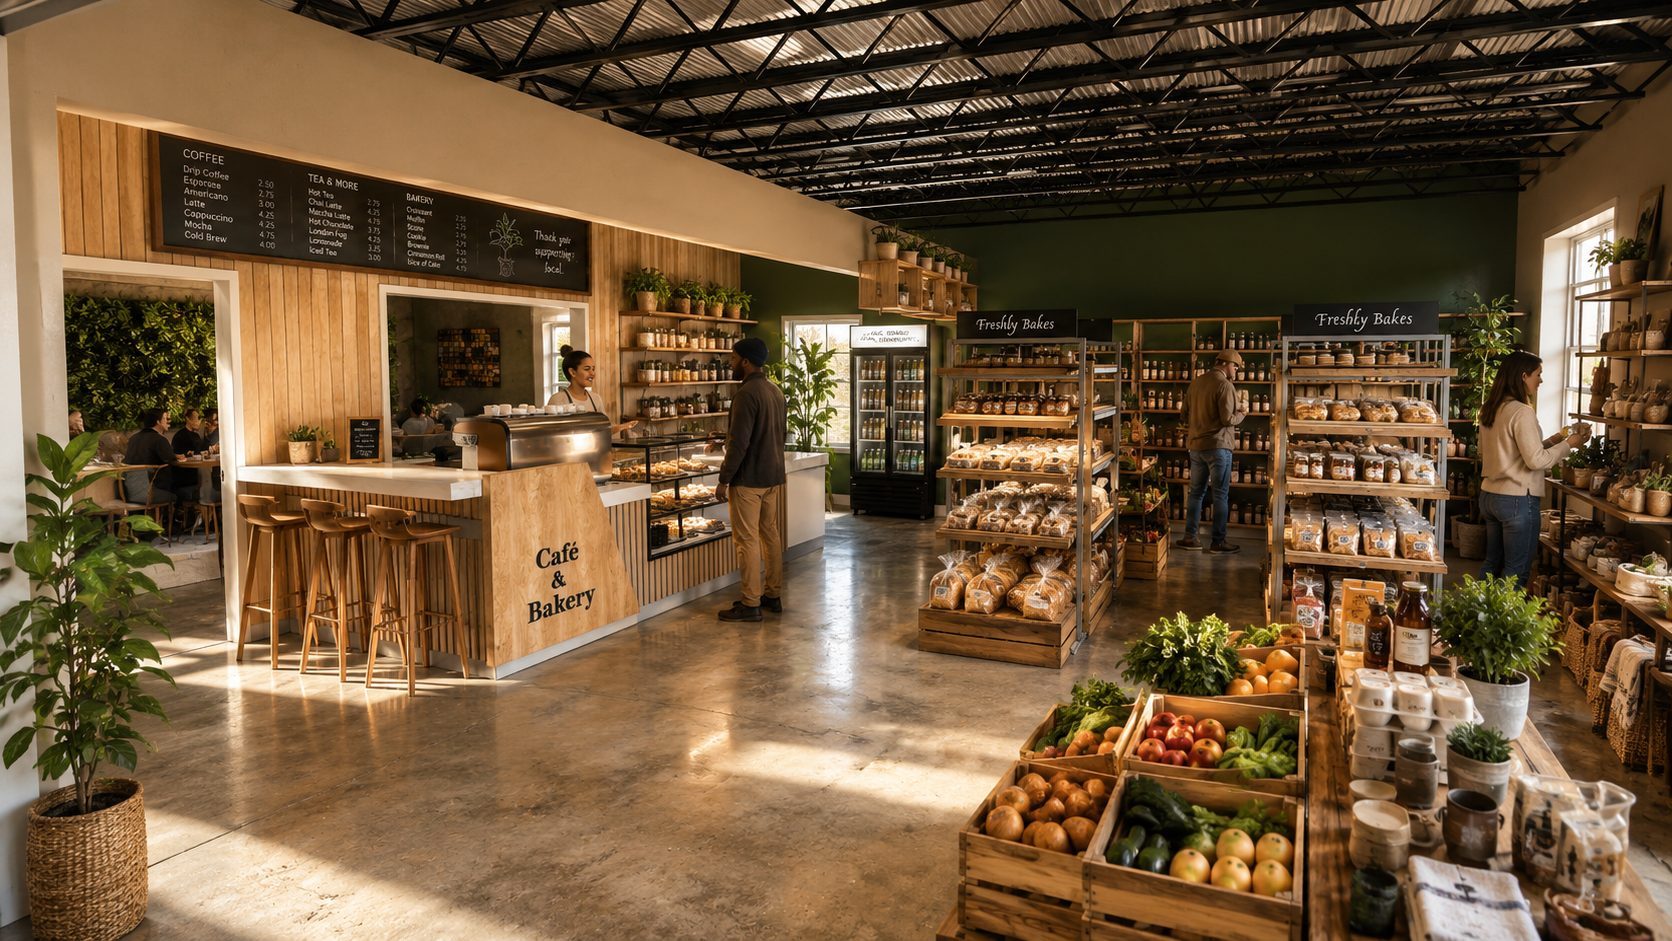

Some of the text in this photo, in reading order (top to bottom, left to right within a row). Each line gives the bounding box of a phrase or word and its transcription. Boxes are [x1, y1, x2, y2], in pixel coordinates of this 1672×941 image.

[183, 148, 225, 165] COFFEE
[183, 164, 201, 177] Drip
[308, 173, 359, 191] TEA & MORE
[184, 230, 204, 240] Cold
[206, 232, 227, 243] Brew
[976, 314, 1055, 336] Freshly Bakes
[1314, 307, 1413, 333] Freshly Bakes
[535, 541, 579, 569] Café
[551, 570, 567, 589] &
[527, 588, 596, 625] Bakery
